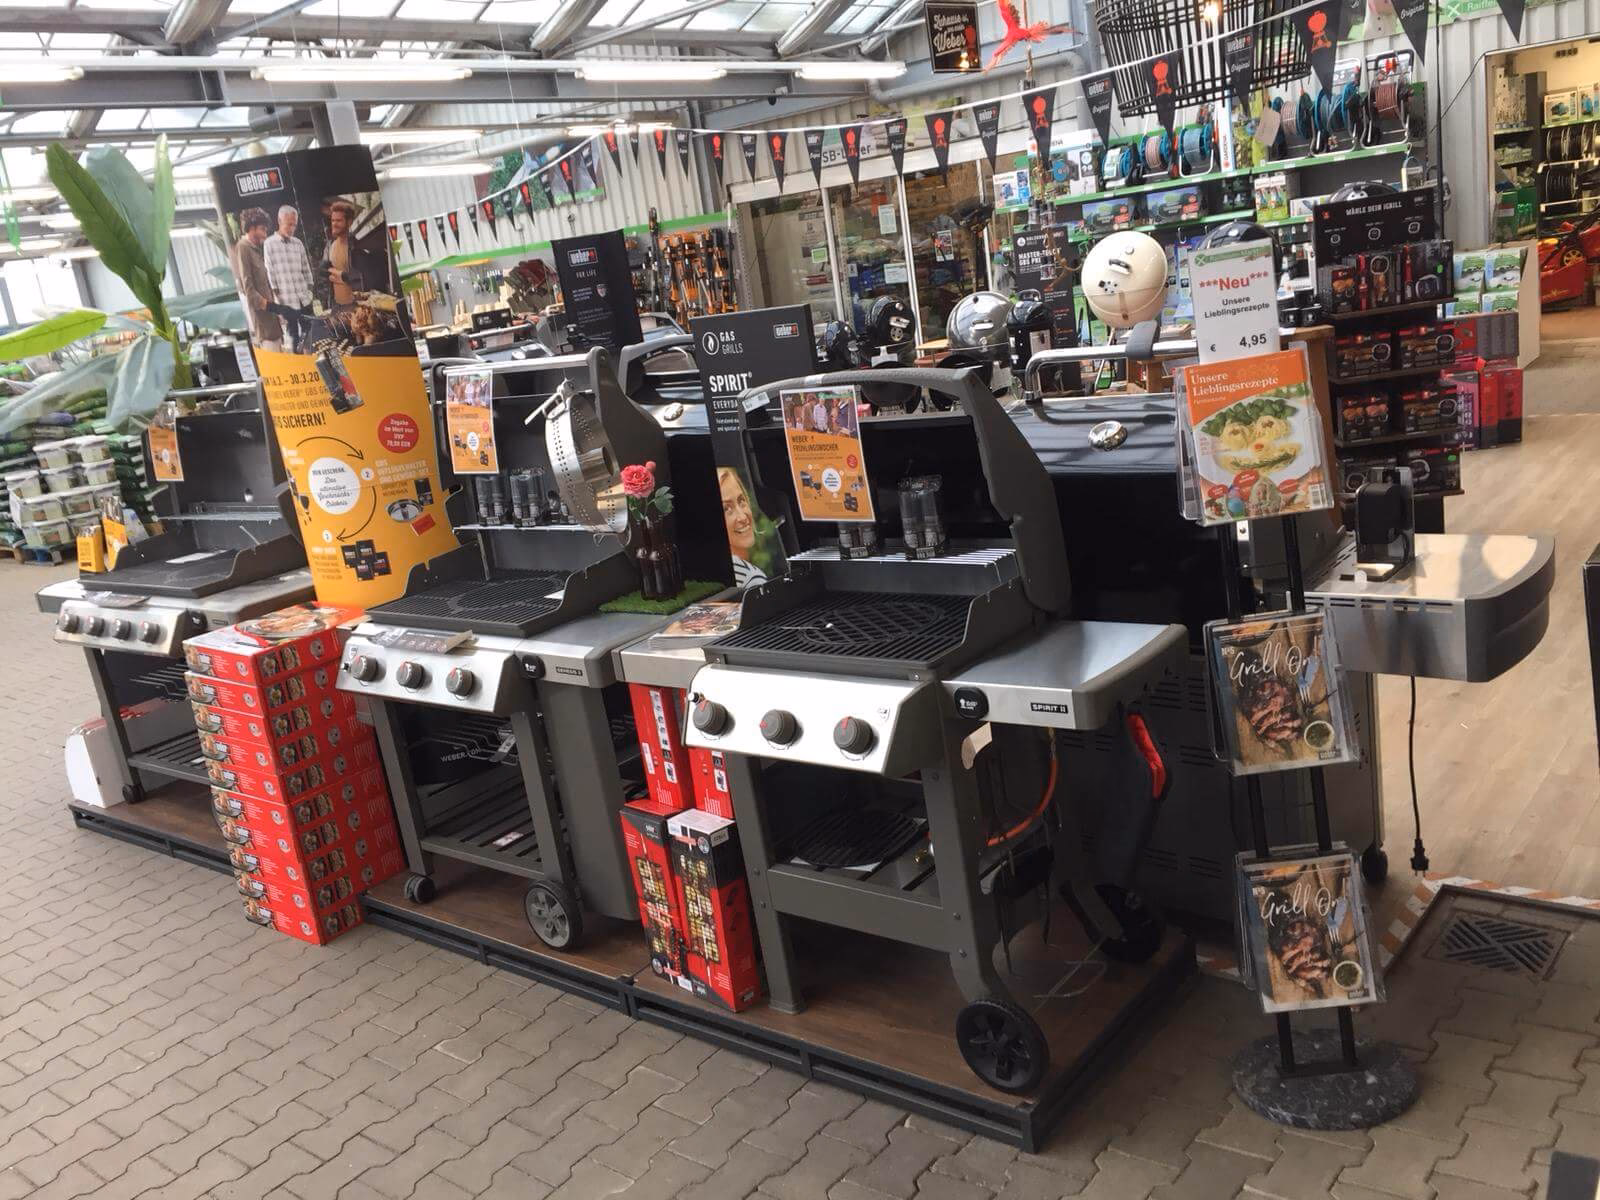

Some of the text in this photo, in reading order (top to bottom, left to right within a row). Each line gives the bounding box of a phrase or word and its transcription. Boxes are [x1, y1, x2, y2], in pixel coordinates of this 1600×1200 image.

[1400, 3, 1425, 20] Original
[933, 32, 966, 52] Weber
[1088, 82, 1105, 95] weber
[979, 108, 992, 120] weber
[239, 169, 269, 193] weber
[570, 249, 589, 264] weber
[1222, 296, 1250, 306] Unsere
[1204, 302, 1270, 318] Lieblingsrezepte
[720, 330, 736, 342] GAS
[776, 325, 792, 337] weber
[722, 343, 744, 354] GRILLS
[1210, 334, 1267, 352] € 4,95
[290, 371, 320, 385] 30.3.20
[1192, 372, 1228, 385] Unsere
[1193, 378, 1279, 397] Lieblingsrezepte
[714, 400, 738, 410] EVERYDA
[284, 412, 326, 428] SICHERN!
[1230, 641, 1282, 687] Grill
[1032, 704, 1058, 712] SPIRIT
[1261, 883, 1312, 927] Grill
